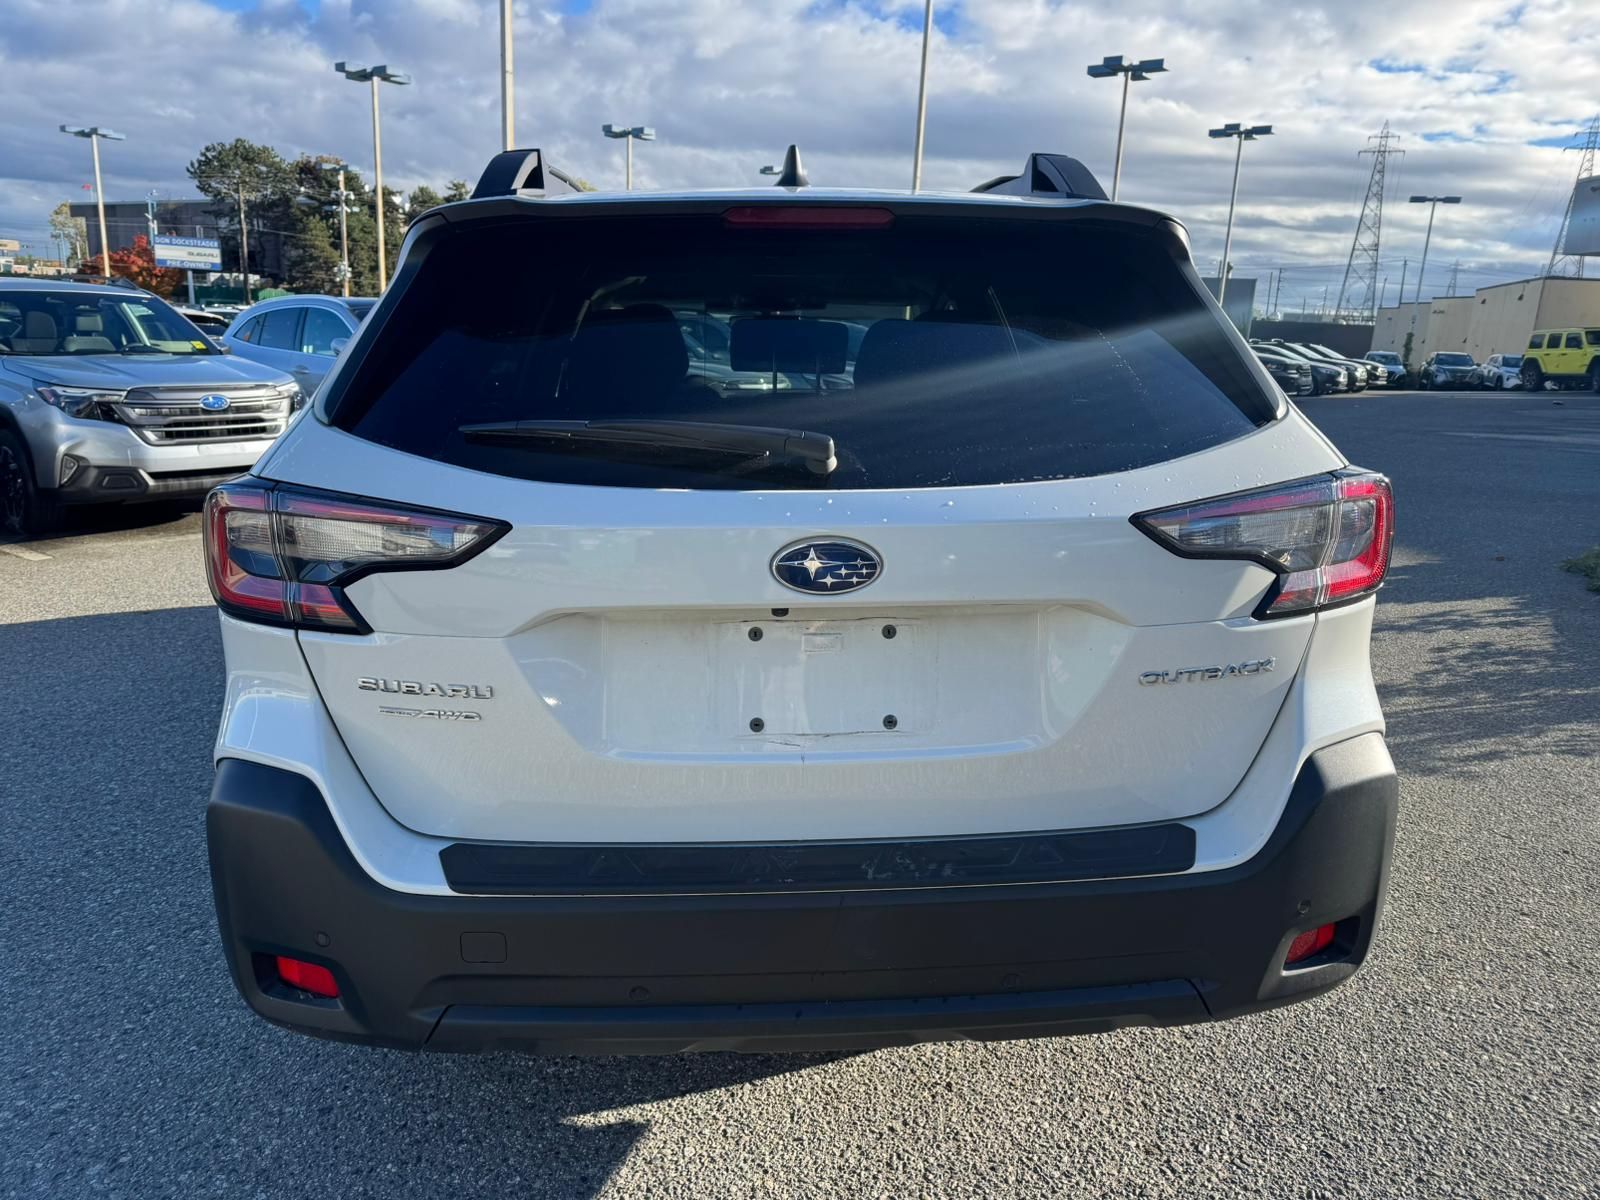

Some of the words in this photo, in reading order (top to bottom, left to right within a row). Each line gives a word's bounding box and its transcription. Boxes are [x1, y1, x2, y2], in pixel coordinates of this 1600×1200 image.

[154, 236, 170, 244] DON
[167, 260, 211, 268] PRE-OWNED
[1138, 656, 1276, 686] OUTBACK
[357, 676, 494, 699] SUBARU
[419, 708, 482, 721] AWD
